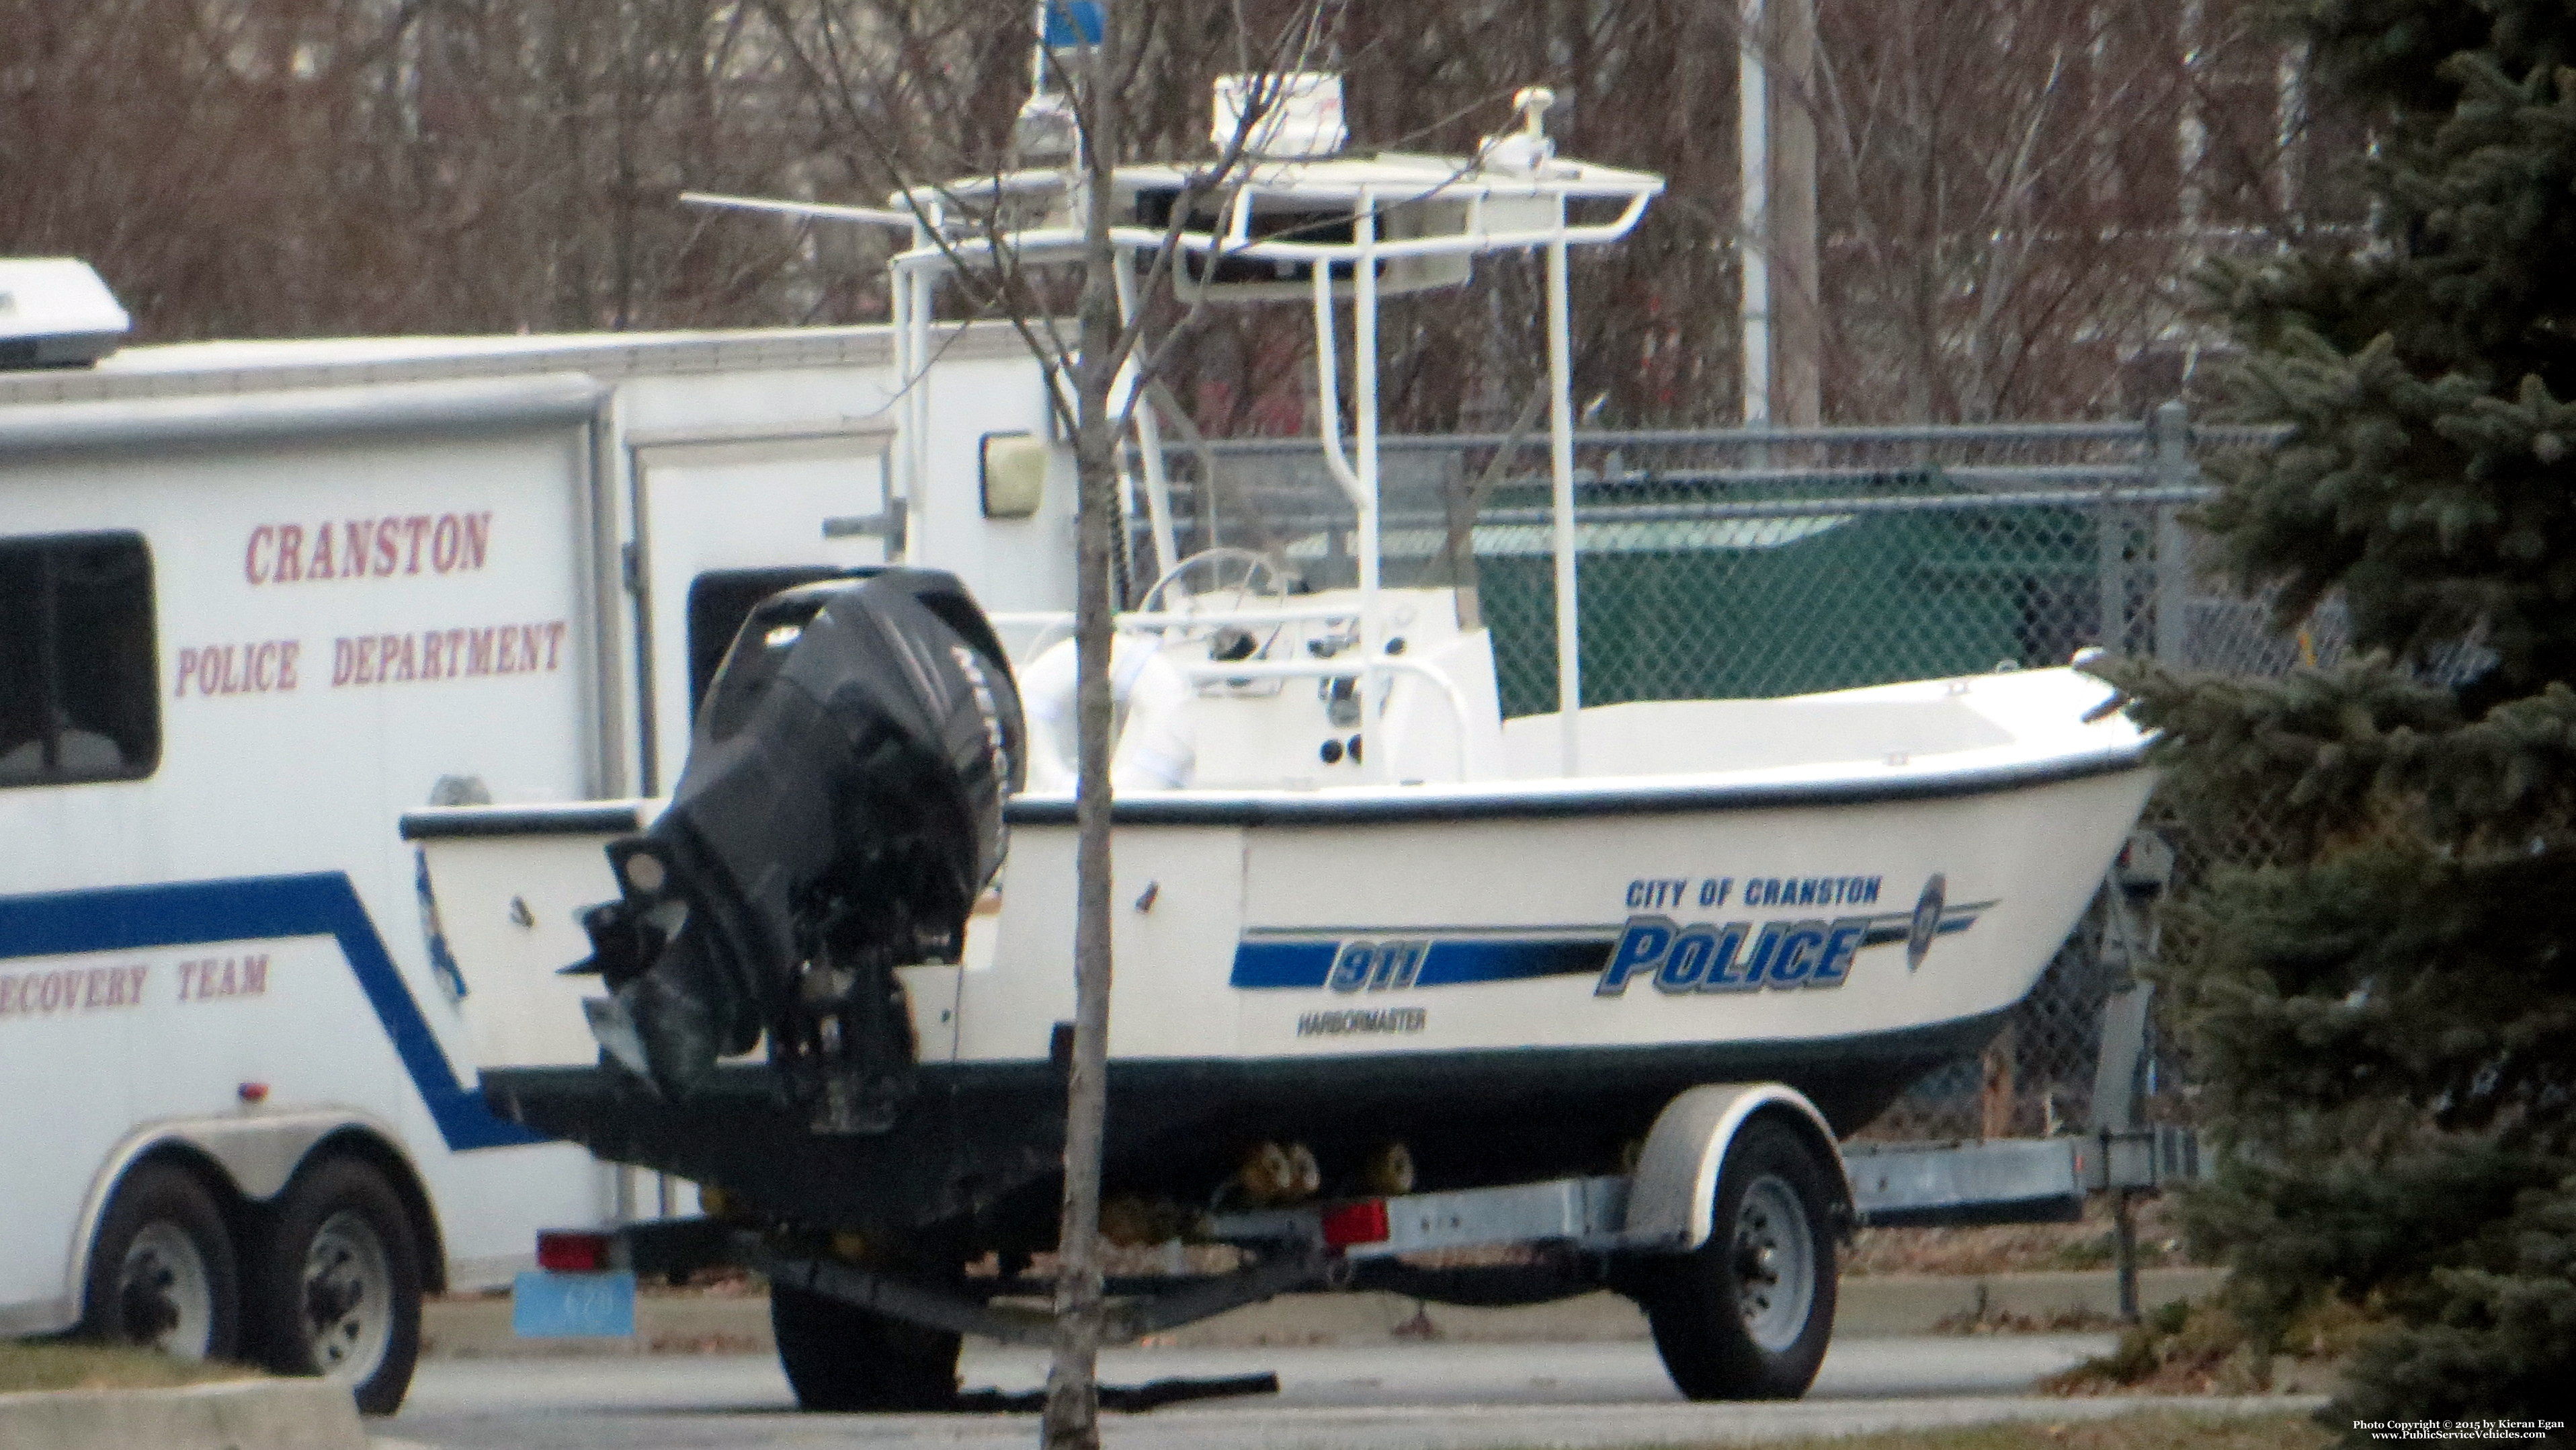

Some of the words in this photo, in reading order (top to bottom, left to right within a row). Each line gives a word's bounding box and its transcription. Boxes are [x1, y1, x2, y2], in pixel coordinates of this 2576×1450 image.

[245, 511, 492, 584] CRANSTON
[175, 639, 300, 696] POLICE
[332, 620, 566, 687] DEPARTMENT
[1626, 879, 1686, 908] CITY
[1699, 877, 1734, 905] OF
[1745, 875, 1882, 906] CRANSTON
[178, 955, 269, 1000] TEAM
[1329, 941, 1430, 994] 911
[1593, 914, 1872, 996] POLICE
